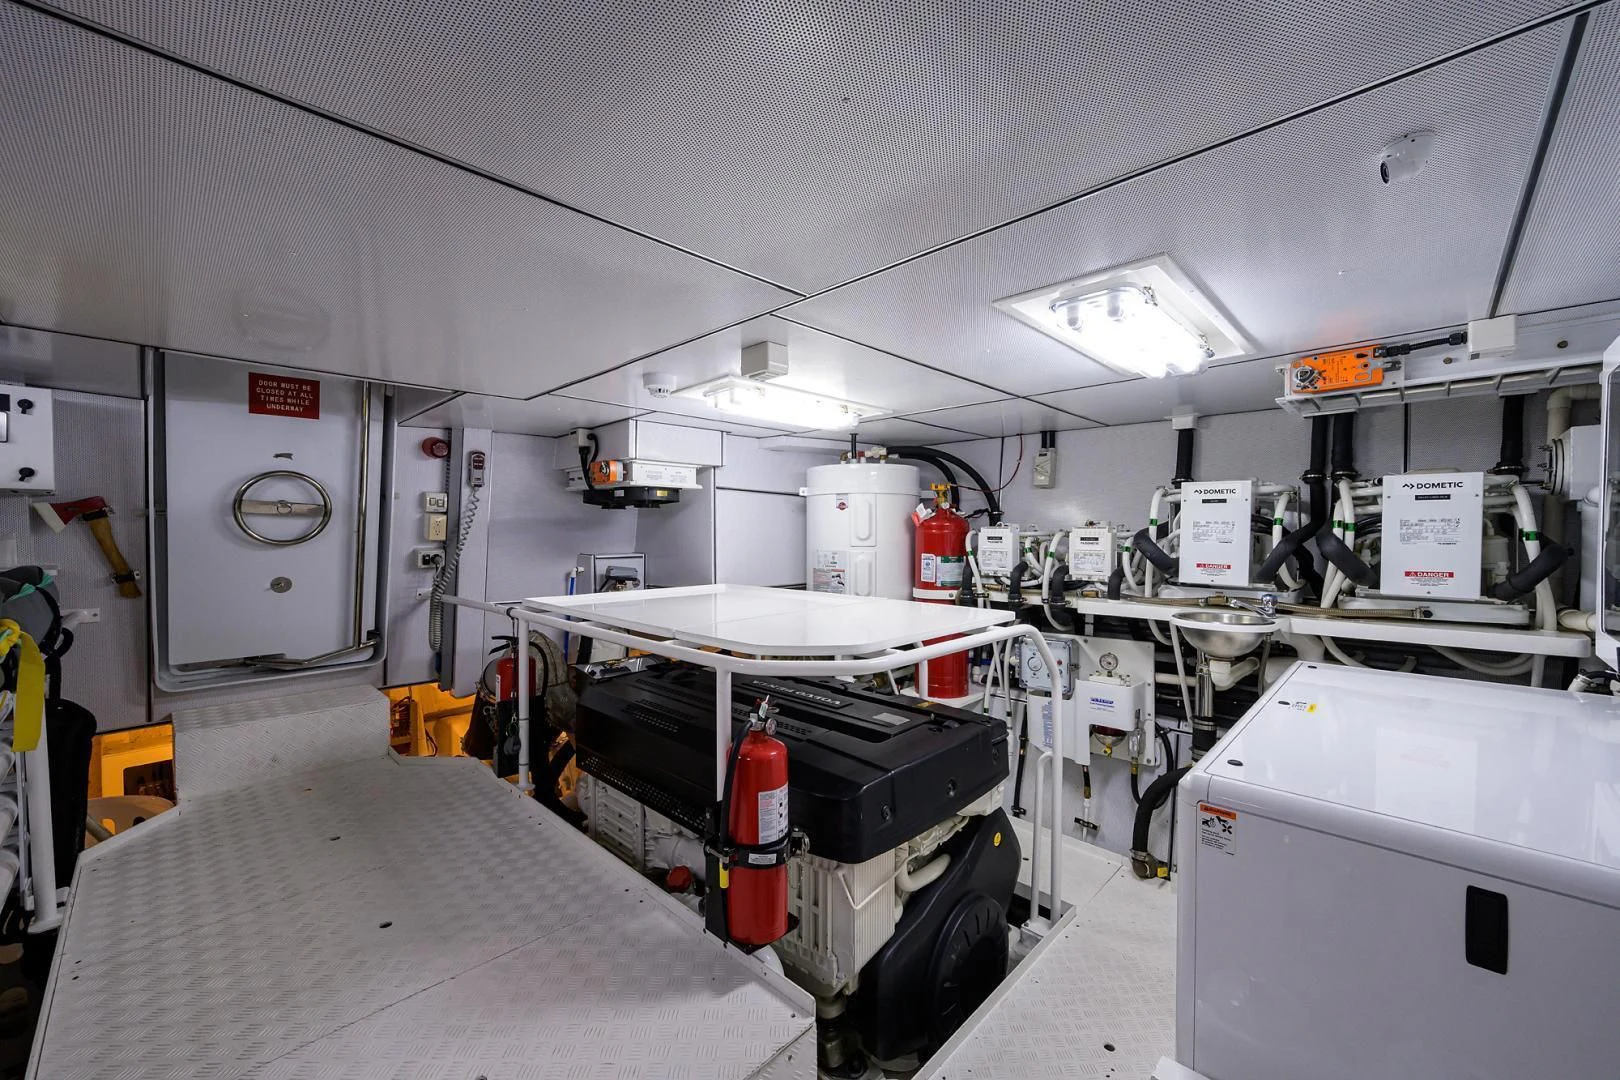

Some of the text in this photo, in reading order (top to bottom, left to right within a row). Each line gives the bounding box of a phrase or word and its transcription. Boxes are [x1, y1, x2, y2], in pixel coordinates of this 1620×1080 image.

[258, 380, 278, 388] DOOR
[280, 382, 299, 390] MUST
[256, 387, 285, 396] CLOSED
[260, 395, 310, 406] TIMES WHILE
[266, 403, 304, 412] UNDERWAY
[1416, 481, 1464, 490] DOMETIC
[752, 680, 841, 705] VOLVO PENTA
